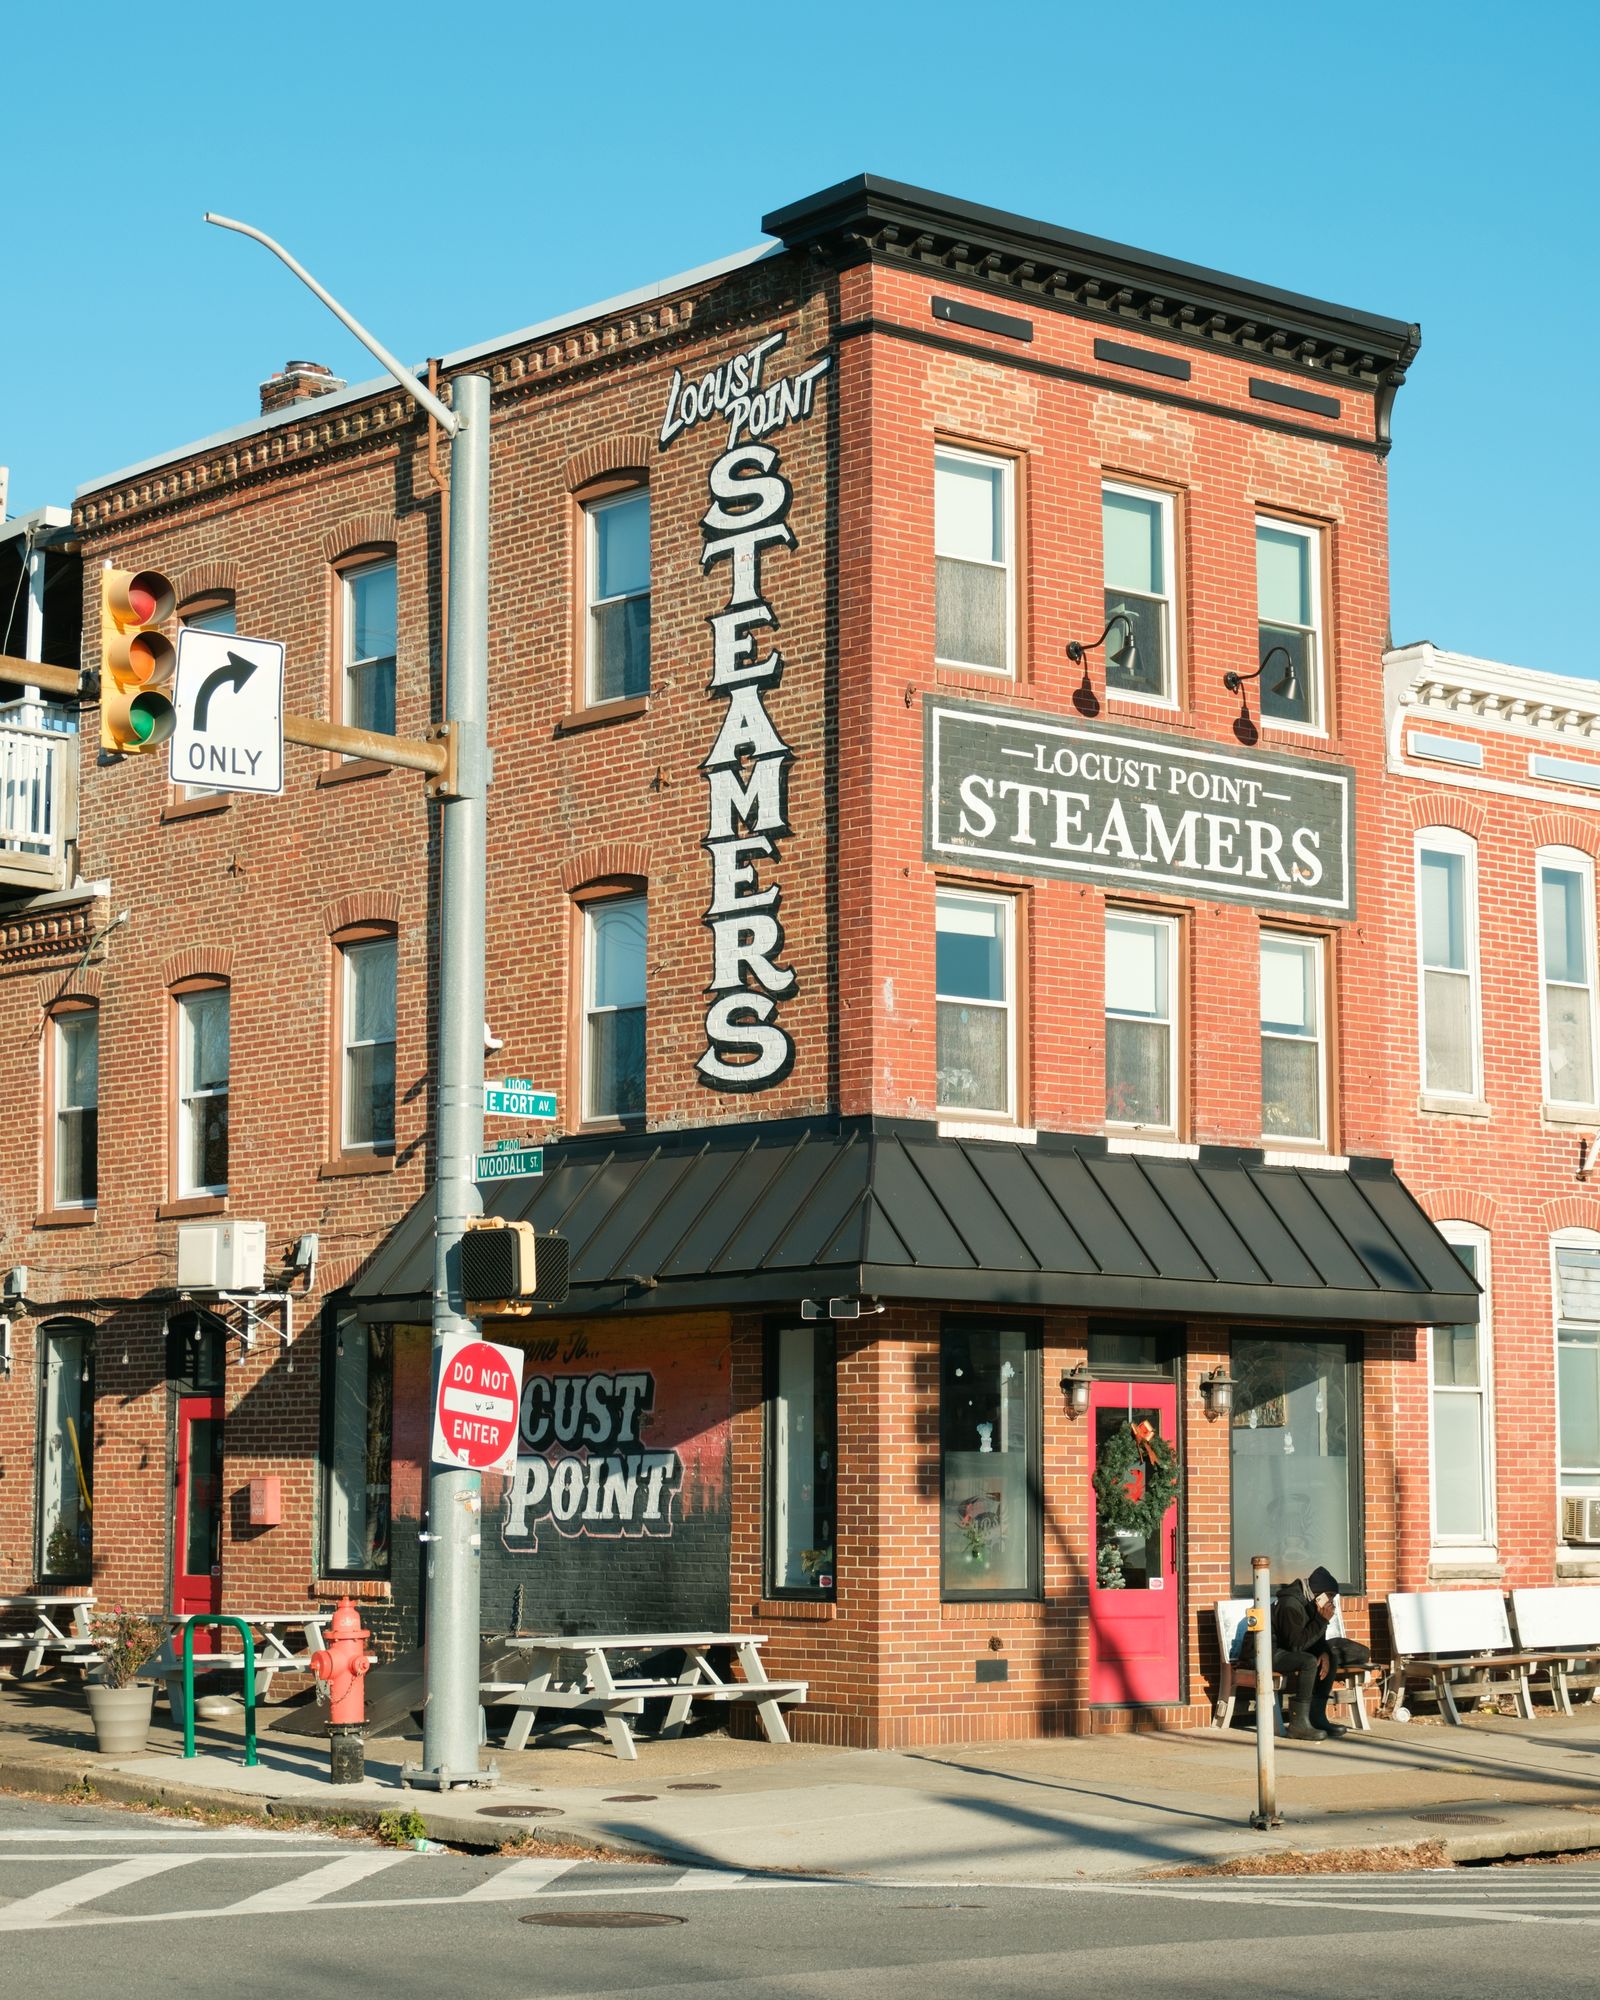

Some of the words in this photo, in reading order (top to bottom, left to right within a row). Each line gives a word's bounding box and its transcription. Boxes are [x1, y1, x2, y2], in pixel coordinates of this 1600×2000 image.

[660, 331, 785, 445] LOCUST
[725, 356, 833, 450] POINT
[189, 742, 263, 776] ONLY
[698, 445, 795, 1087] STEAMERS
[1033, 744, 1161, 791] LOCUST
[1169, 767, 1262, 808] POINT
[958, 774, 1323, 886] STEAMERS
[490, 1092, 499, 1110] E.
[503, 1094, 535, 1113] FORT
[539, 1101, 551, 1112] AV.
[508, 1079, 527, 1090] 1100
[480, 1155, 526, 1176] WOODALL
[530, 1156, 539, 1168] ST.
[503, 1140, 518, 1151] 1400
[453, 1362, 474, 1384] DO
[481, 1368, 510, 1391] NOT
[453, 1419, 500, 1446] ENTER
[521, 1375, 649, 1444] CUST
[505, 1453, 676, 1537] POINT
